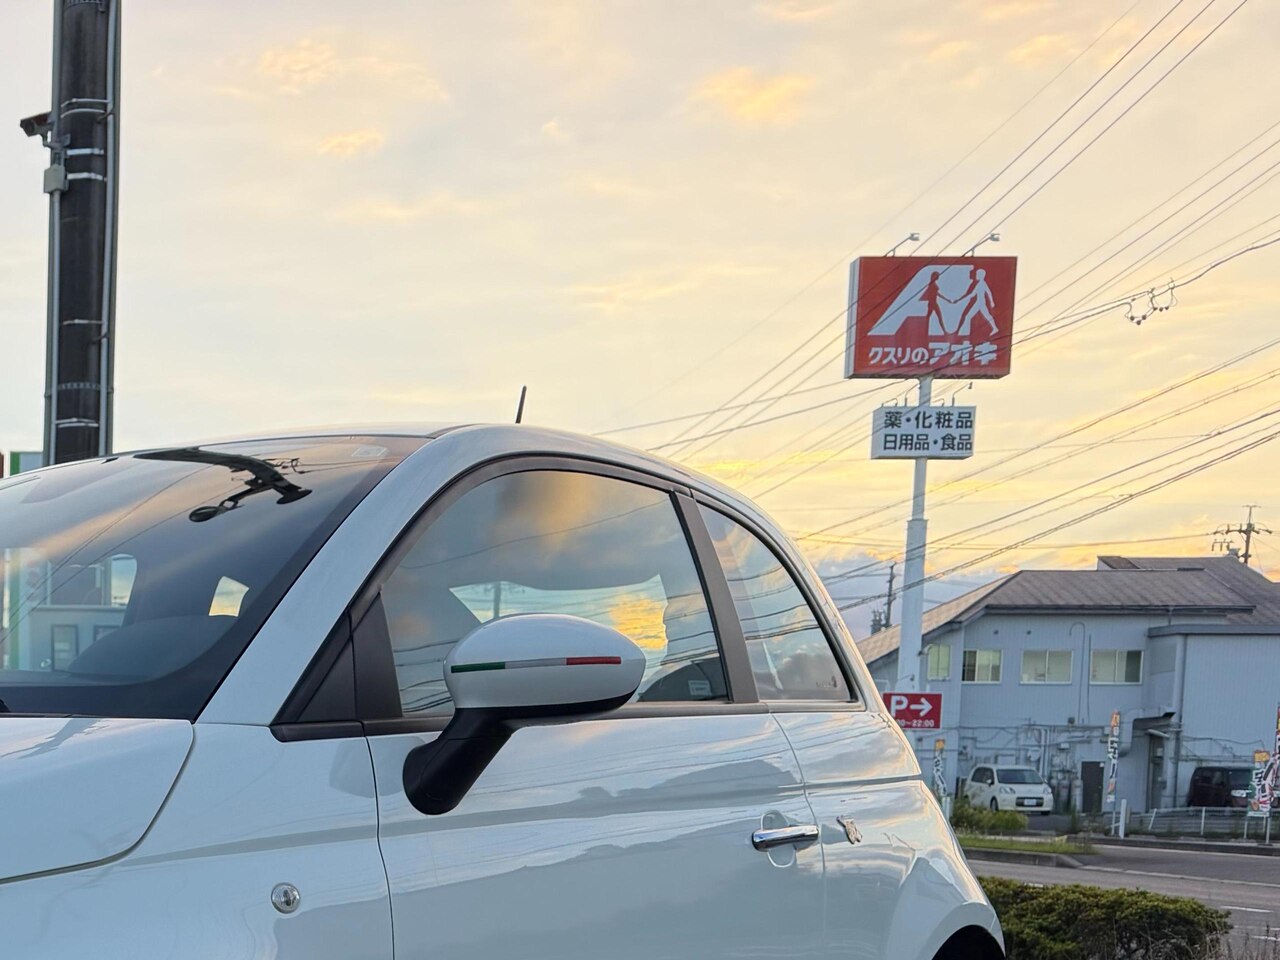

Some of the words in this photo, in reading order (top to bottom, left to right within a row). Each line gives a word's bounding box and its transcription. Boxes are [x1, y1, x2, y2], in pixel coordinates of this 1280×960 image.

[868, 341, 998, 365] クスリのアオキ
[883, 410, 973, 430] 薬・化粧品
[883, 432, 973, 451] 日用品・食品
[890, 695, 909, 718] P
